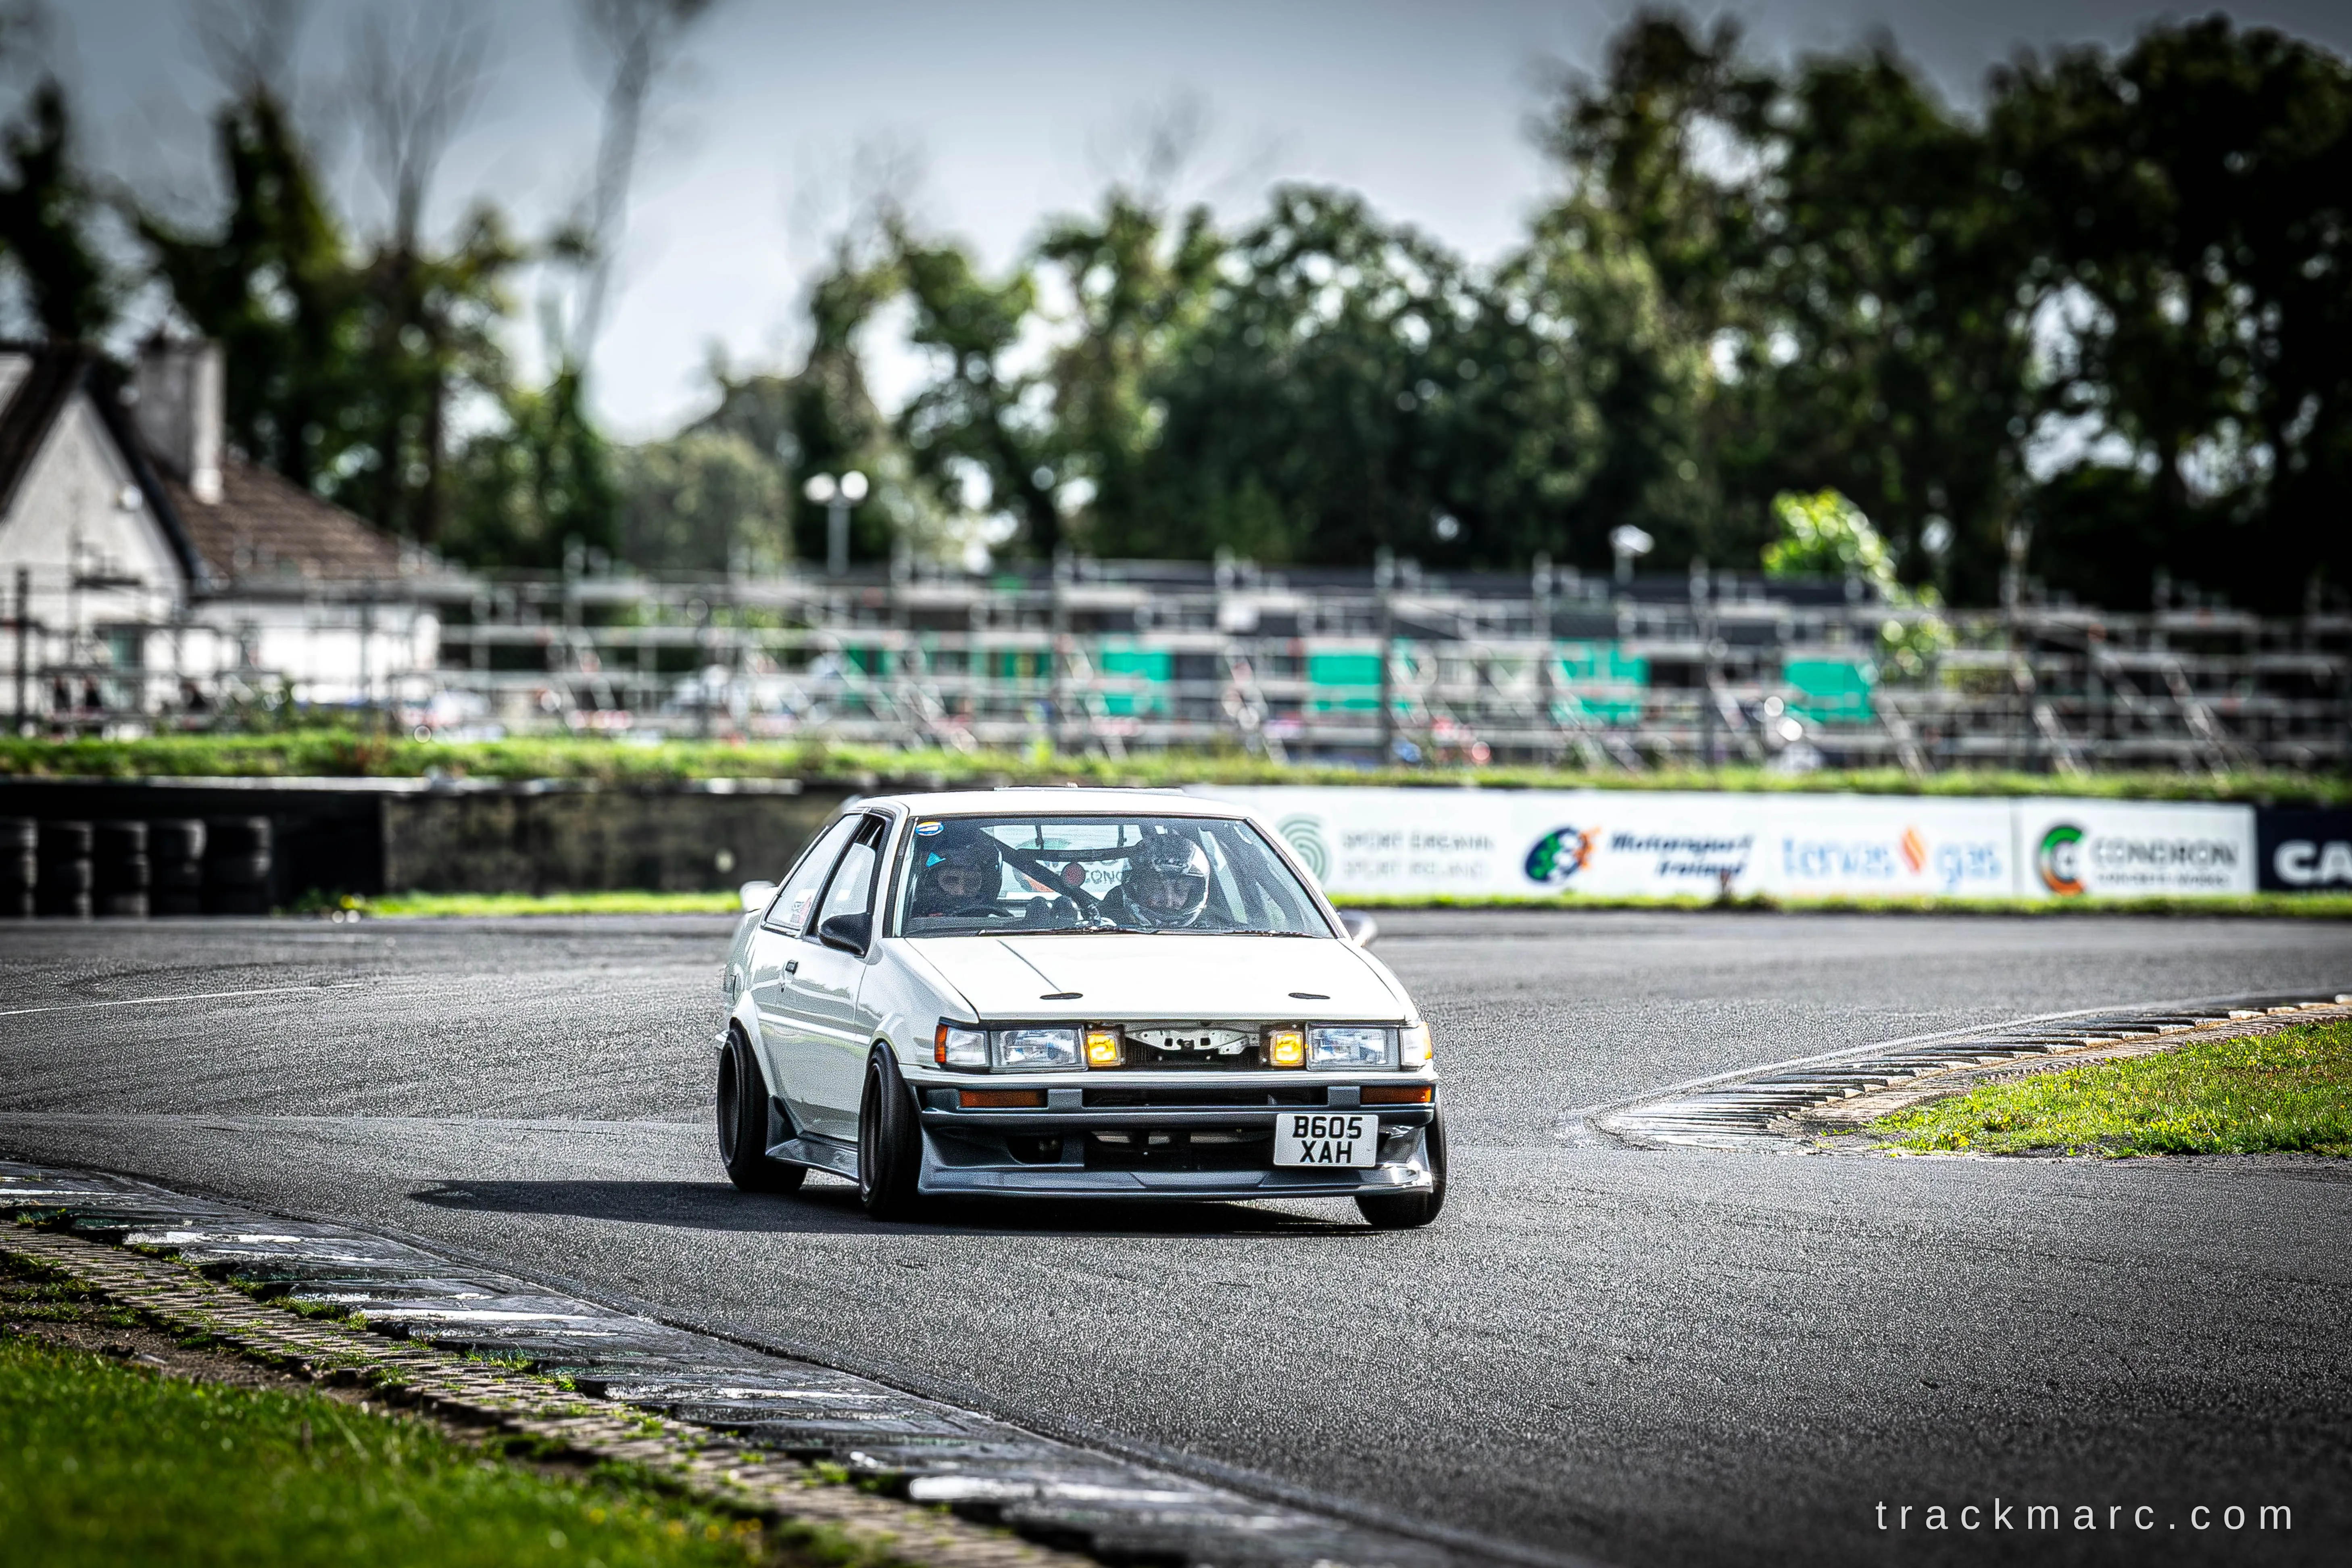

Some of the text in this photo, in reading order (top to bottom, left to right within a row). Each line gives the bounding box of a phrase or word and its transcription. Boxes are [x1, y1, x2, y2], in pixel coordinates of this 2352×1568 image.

[1936, 842, 2003, 892] gas
[1293, 1116, 1363, 1139] B605
[1299, 1140, 1352, 1163] XAH
